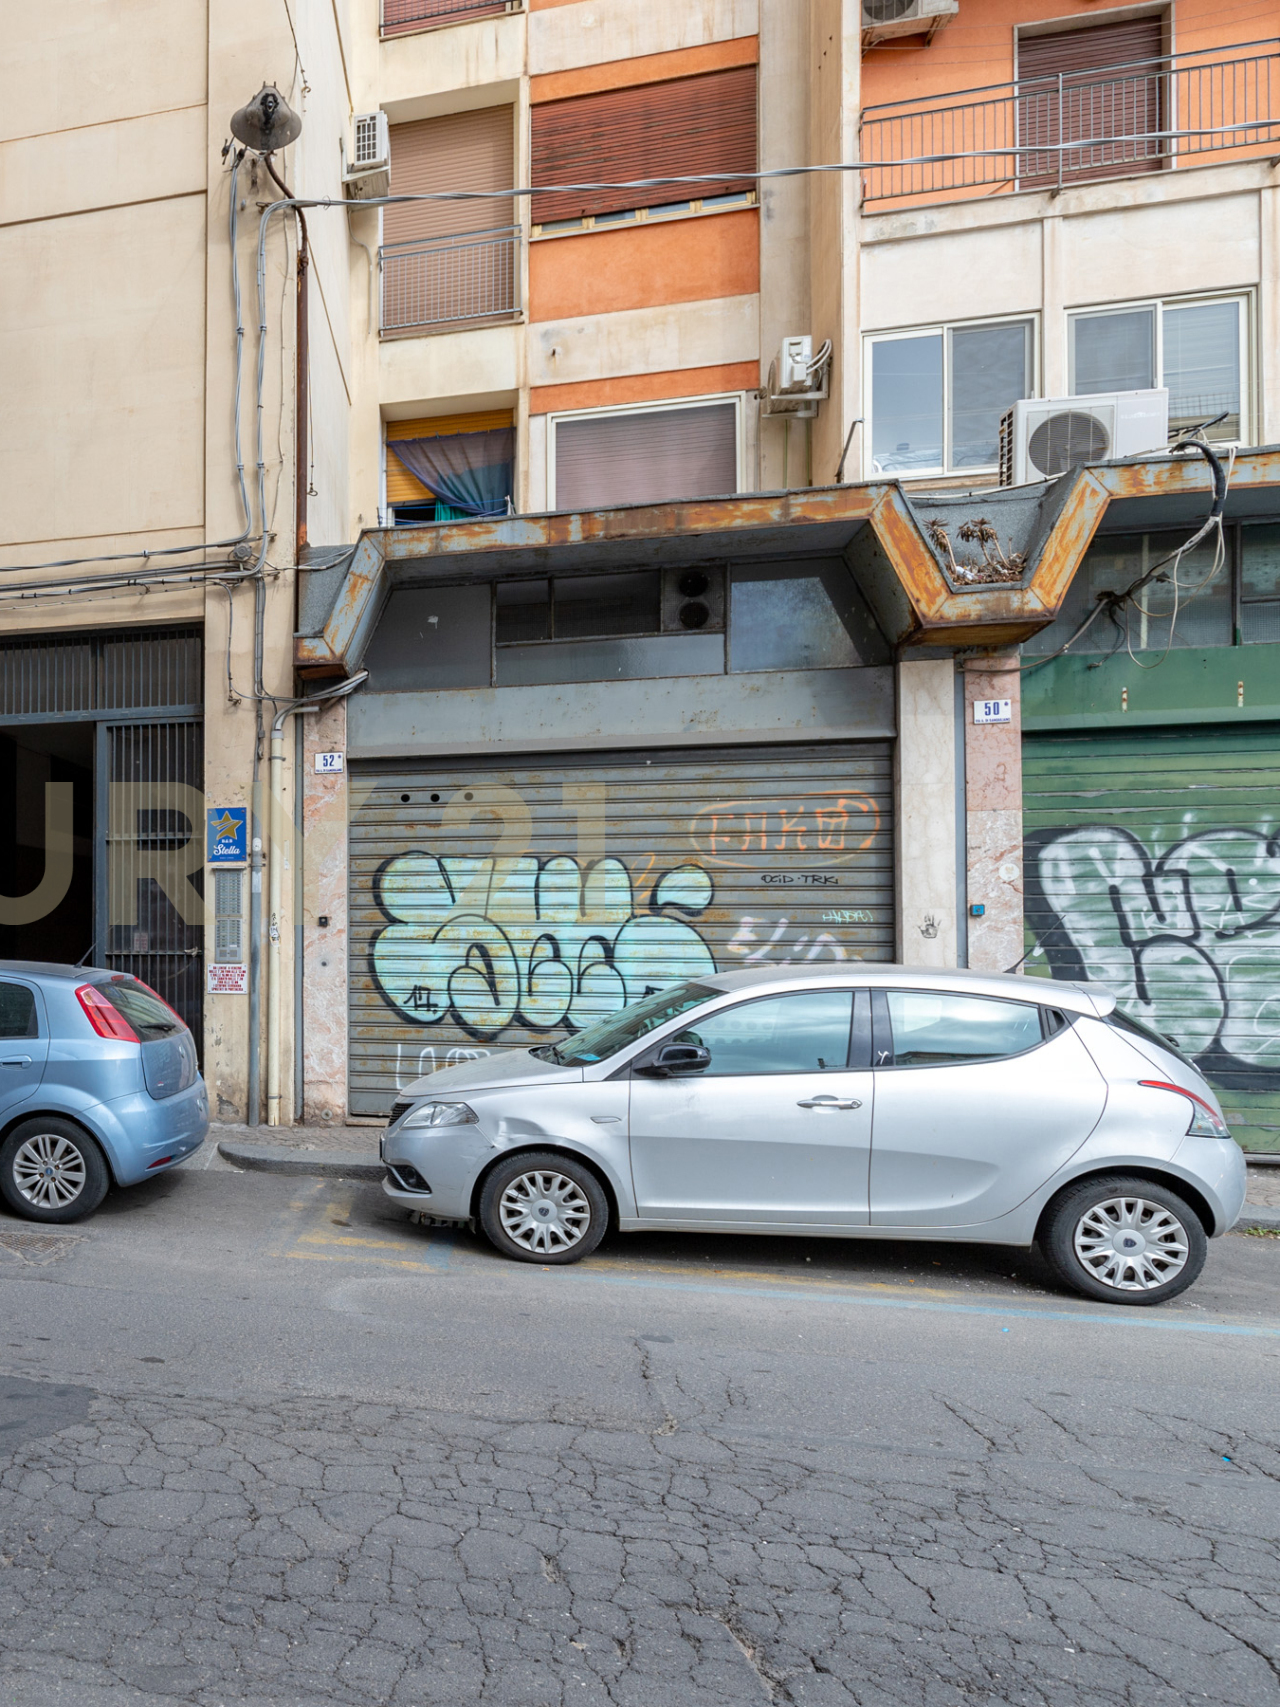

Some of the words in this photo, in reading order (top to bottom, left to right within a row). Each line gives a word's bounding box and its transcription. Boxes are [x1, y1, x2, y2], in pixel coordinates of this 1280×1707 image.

[985, 702, 1000, 716] 50
[322, 754, 335, 767] 52
[213, 844, 240, 856] Stella
